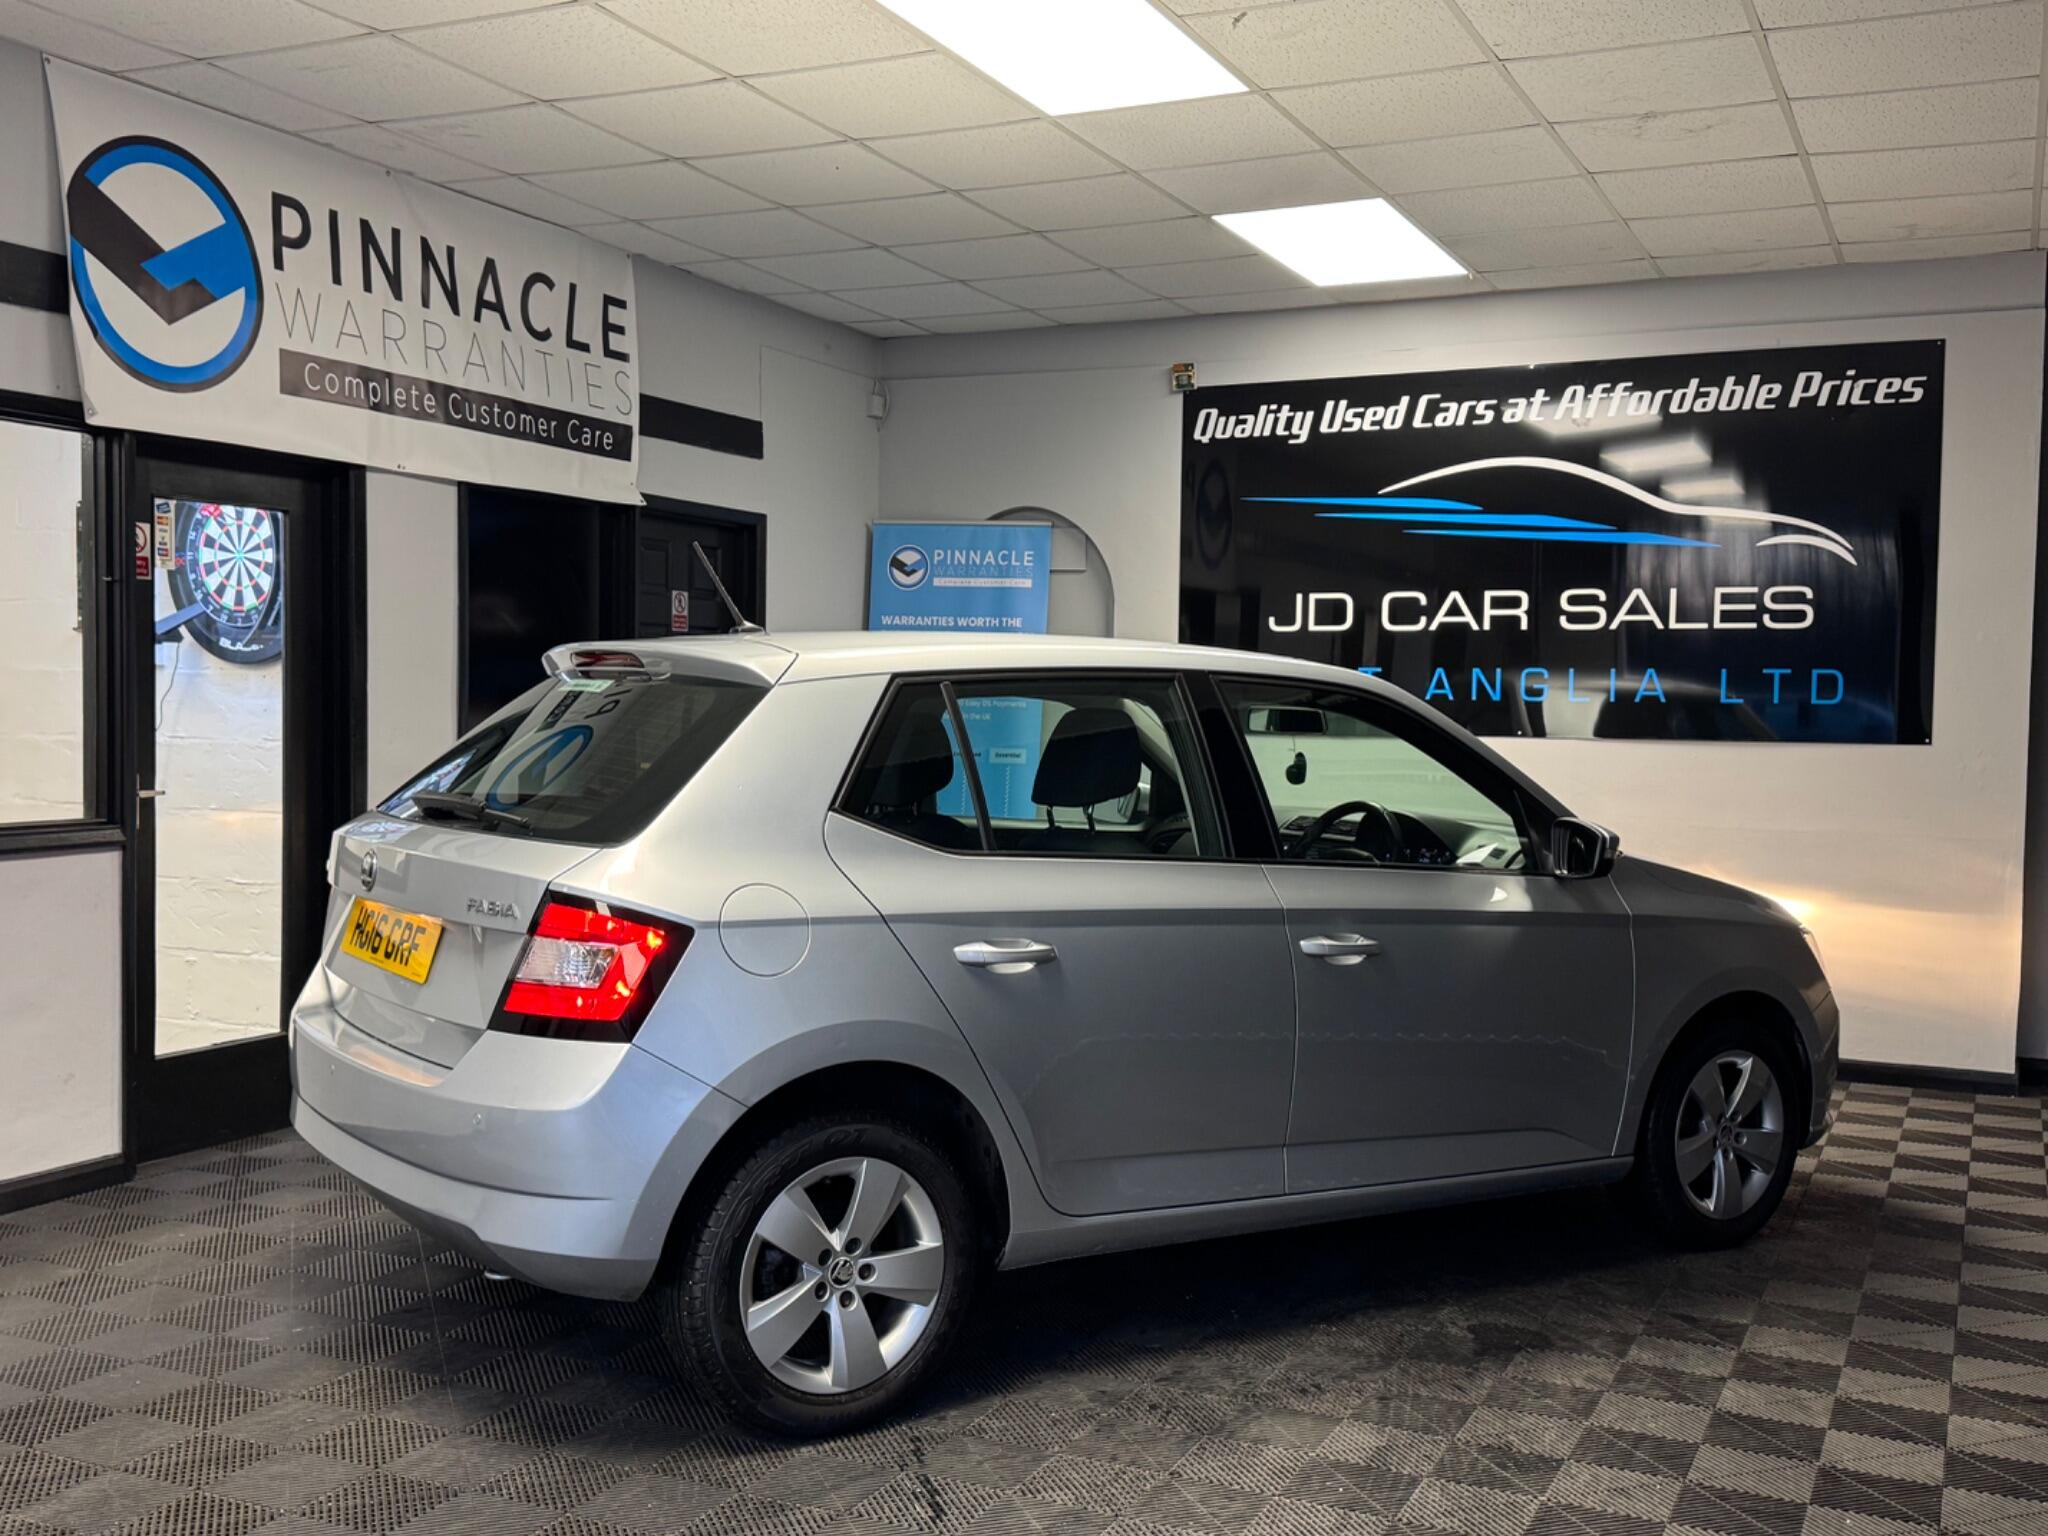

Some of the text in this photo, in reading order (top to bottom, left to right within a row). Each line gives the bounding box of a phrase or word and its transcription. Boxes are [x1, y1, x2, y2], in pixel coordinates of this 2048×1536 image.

[271, 191, 631, 363] PINNACLE
[275, 282, 633, 416] WARRANTIES
[304, 362, 614, 450] Complete Customer Care
[1193, 369, 1928, 444] Quality Used Cars at Affordable Prices
[934, 549, 1035, 566] PINNACLE
[881, 615, 1023, 627] WARRANTIES WORTH THE
[1268, 586, 1815, 632] JD CAR SALES
[1425, 667, 1845, 705] ANGLIA LTD
